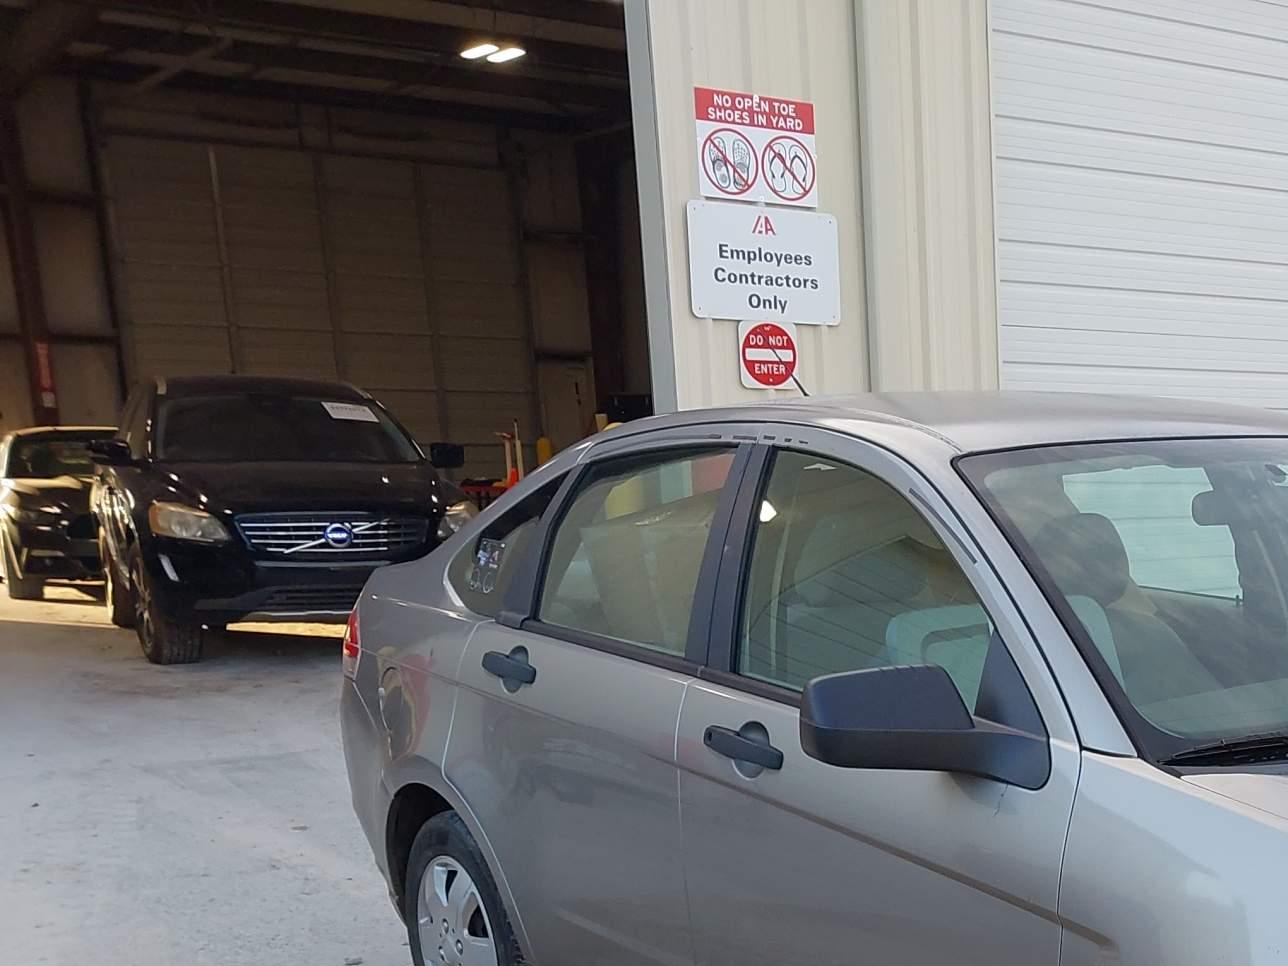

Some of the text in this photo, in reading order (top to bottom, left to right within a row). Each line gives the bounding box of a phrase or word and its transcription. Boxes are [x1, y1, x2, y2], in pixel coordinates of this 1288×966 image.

[713, 93, 796, 117] NO OPEN TOE
[707, 107, 803, 131] SHOES IN YARD
[718, 243, 812, 267] Employees
[713, 267, 819, 290] Contractors
[747, 293, 788, 314] Only
[749, 334, 788, 347] DO NOT
[754, 363, 786, 375] ENTER
